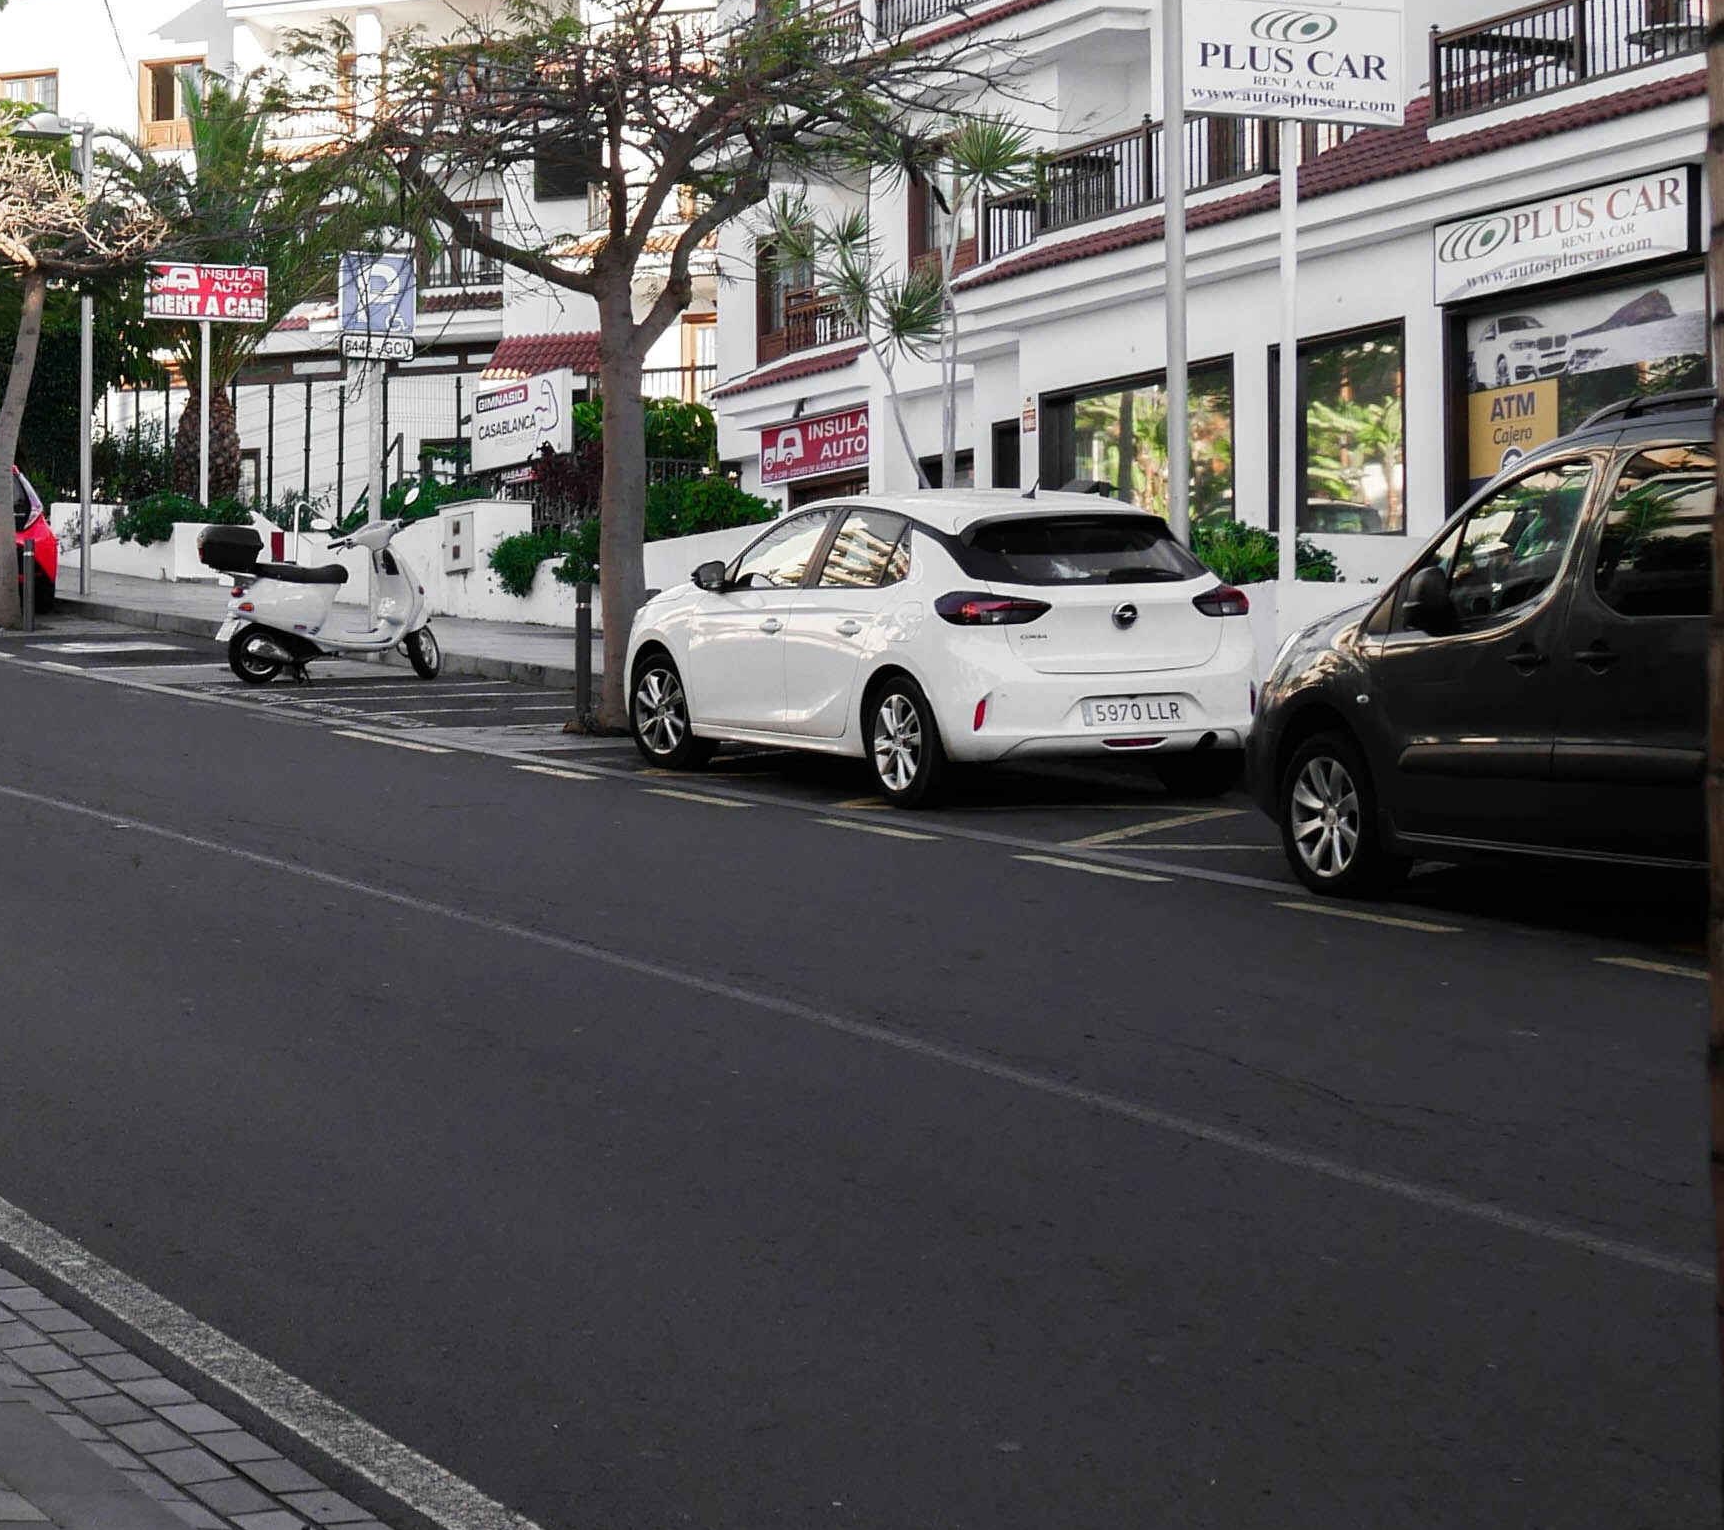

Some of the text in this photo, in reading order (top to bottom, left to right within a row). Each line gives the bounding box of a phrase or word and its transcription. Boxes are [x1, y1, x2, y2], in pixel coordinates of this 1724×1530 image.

[1198, 42, 1388, 81] PLUS CAR
[1253, 75, 1336, 91] RENT A CAR
[1191, 87, 1396, 113] www.autospluscar.com
[1511, 177, 1684, 245] PLUS CAR
[1560, 222, 1636, 250] RENT A CAR
[200, 268, 264, 282] INSULAR
[1466, 237, 1652, 289] www.autospluscar.com
[211, 281, 253, 294] AUTO
[152, 294, 264, 318] RENT A CAR
[478, 388, 525, 410] GIMNASIO
[1490, 390, 1535, 422] ATM
[478, 414, 536, 441] CASABLANCA
[1493, 425, 1533, 446] Cajero
[820, 435, 868, 460] AUTO
[1095, 701, 1181, 723] 5970 LLR
